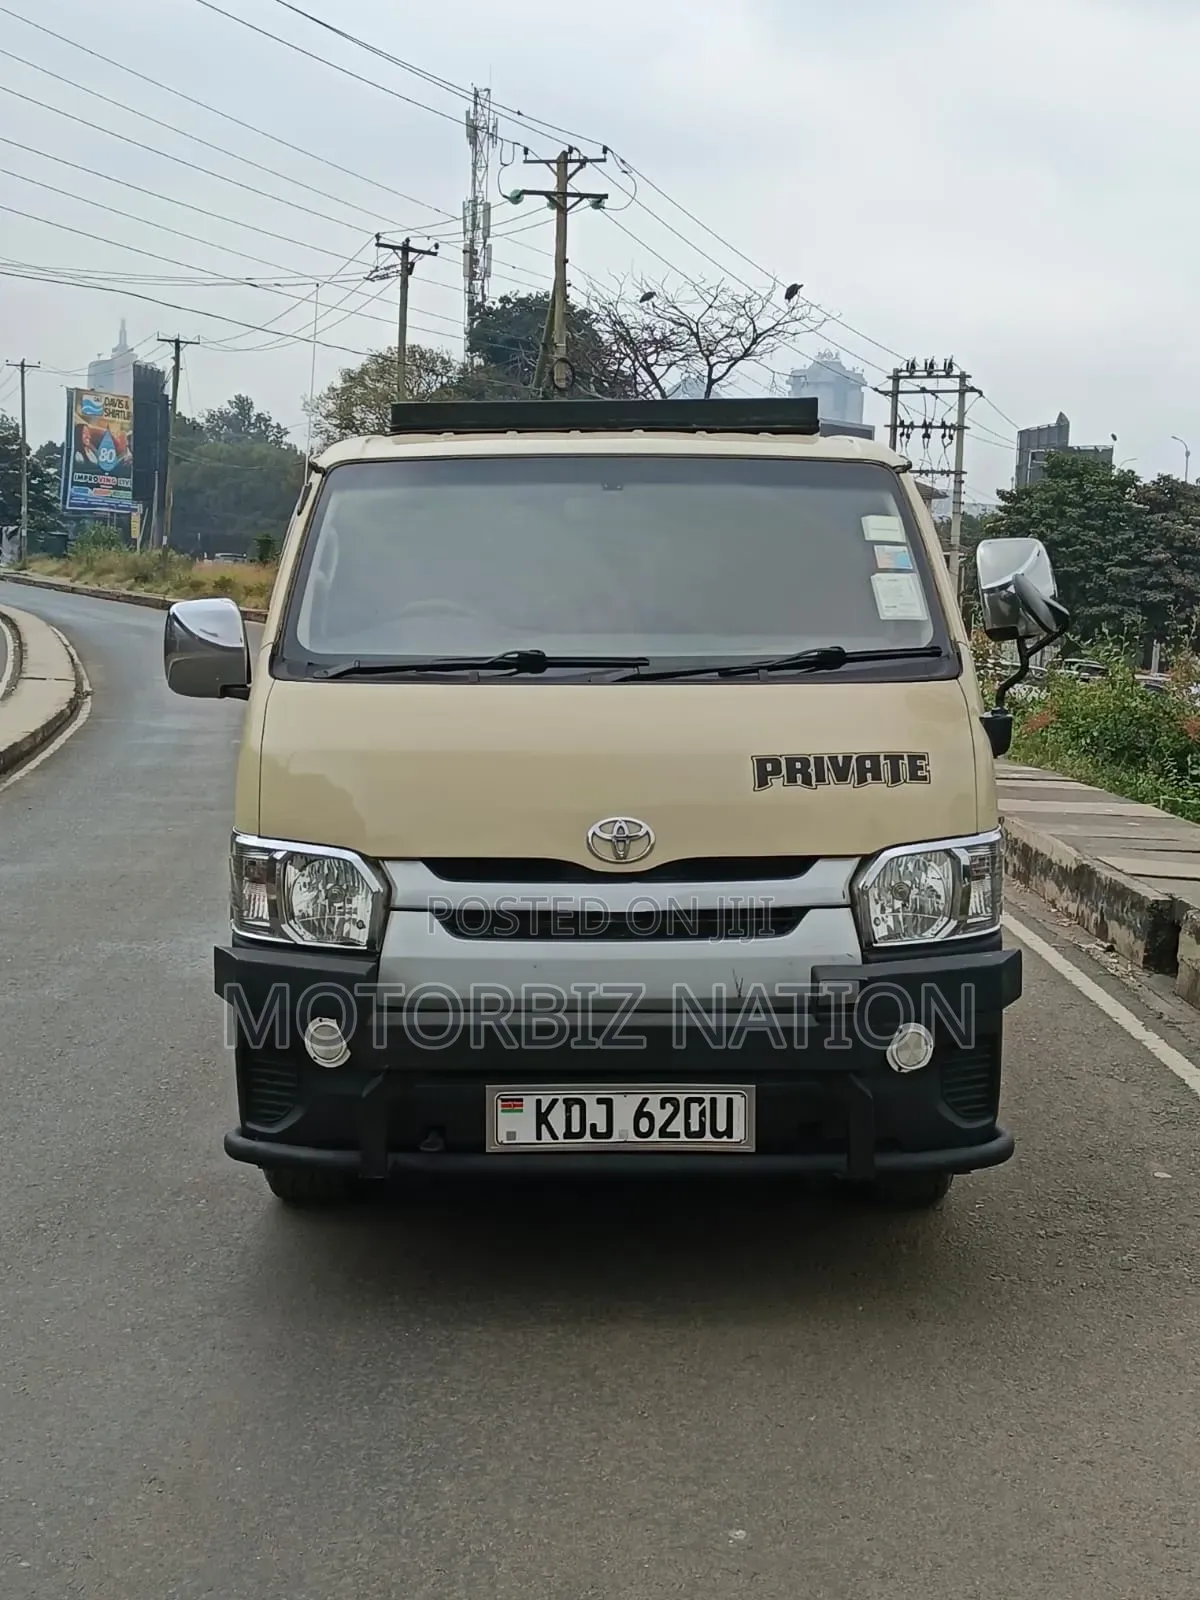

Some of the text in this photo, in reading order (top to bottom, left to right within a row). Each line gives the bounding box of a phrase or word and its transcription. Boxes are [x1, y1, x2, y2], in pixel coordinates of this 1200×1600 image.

[104, 397, 124, 409] DAVIS
[99, 447, 116, 462] 80
[73, 473, 117, 486] IMPROVING
[751, 752, 931, 792] PRIVATE
[535, 1096, 735, 1141] KDJ 620U
